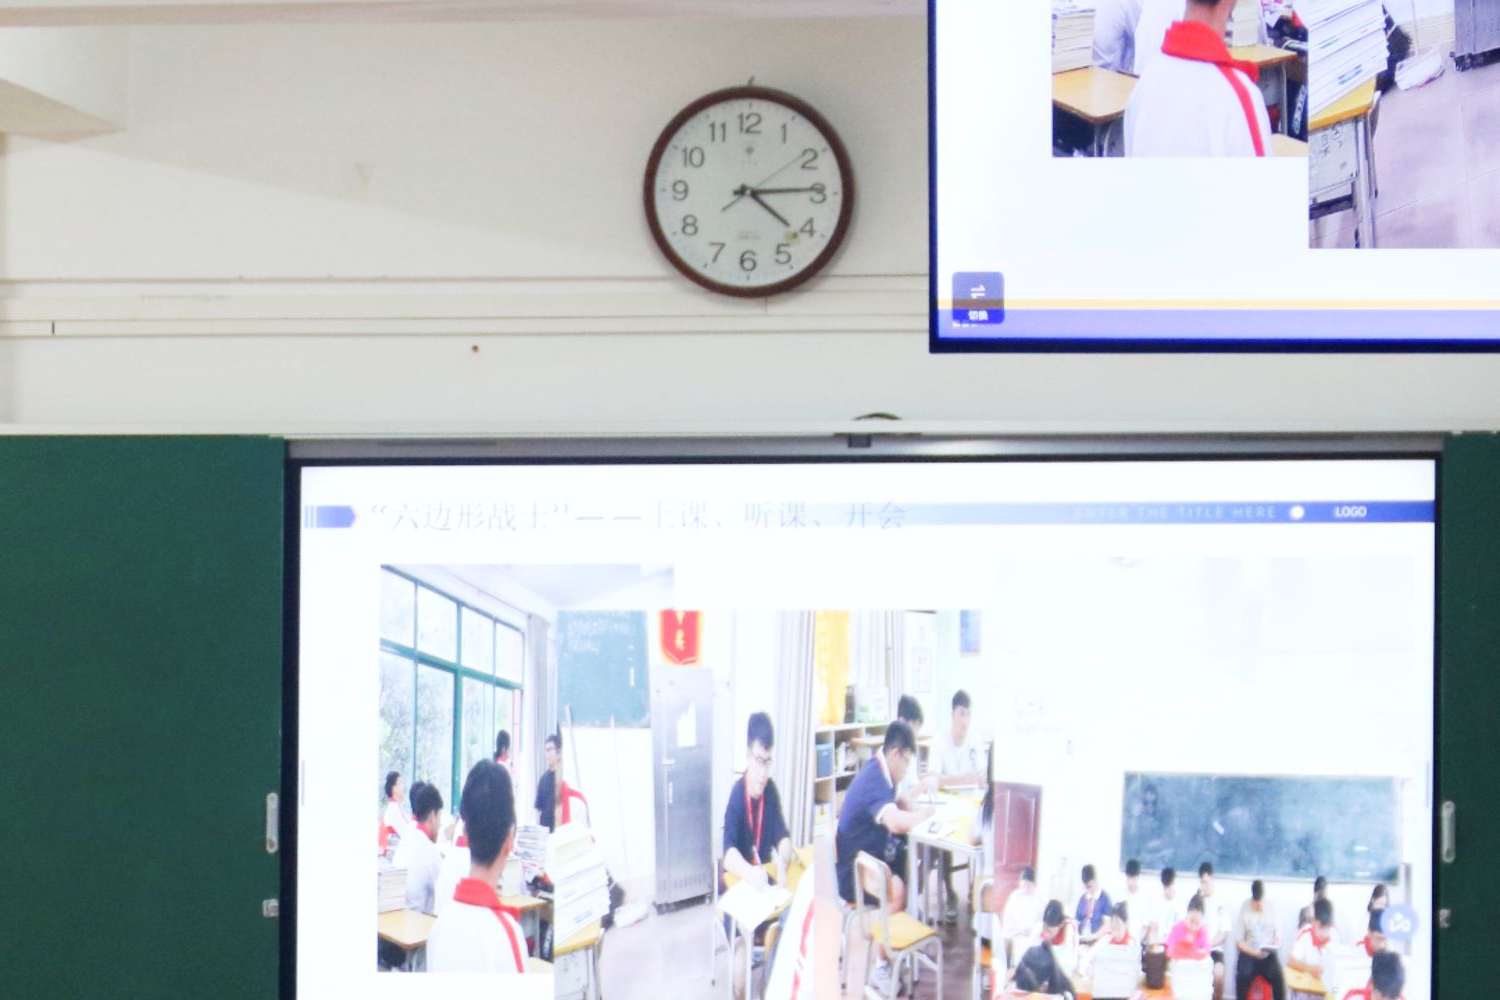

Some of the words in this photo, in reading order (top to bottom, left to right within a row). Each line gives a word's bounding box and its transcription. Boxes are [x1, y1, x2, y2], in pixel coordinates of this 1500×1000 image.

[709, 122, 726, 142] 11
[738, 113, 762, 134] 12
[683, 147, 705, 168] 10
[801, 148, 818, 169] 2
[672, 180, 689, 201] 9
[809, 183, 827, 204] 3
[682, 215, 698, 235] 8
[800, 217, 816, 237] 4
[709, 243, 726, 263] 7
[740, 250, 757, 271] 6
[775, 243, 792, 264] 5
[1139, 505, 1168, 520] THE
[1179, 505, 1224, 520] TITLE
[1233, 505, 1277, 520] HERE
[1334, 505, 1368, 519] LOGO
